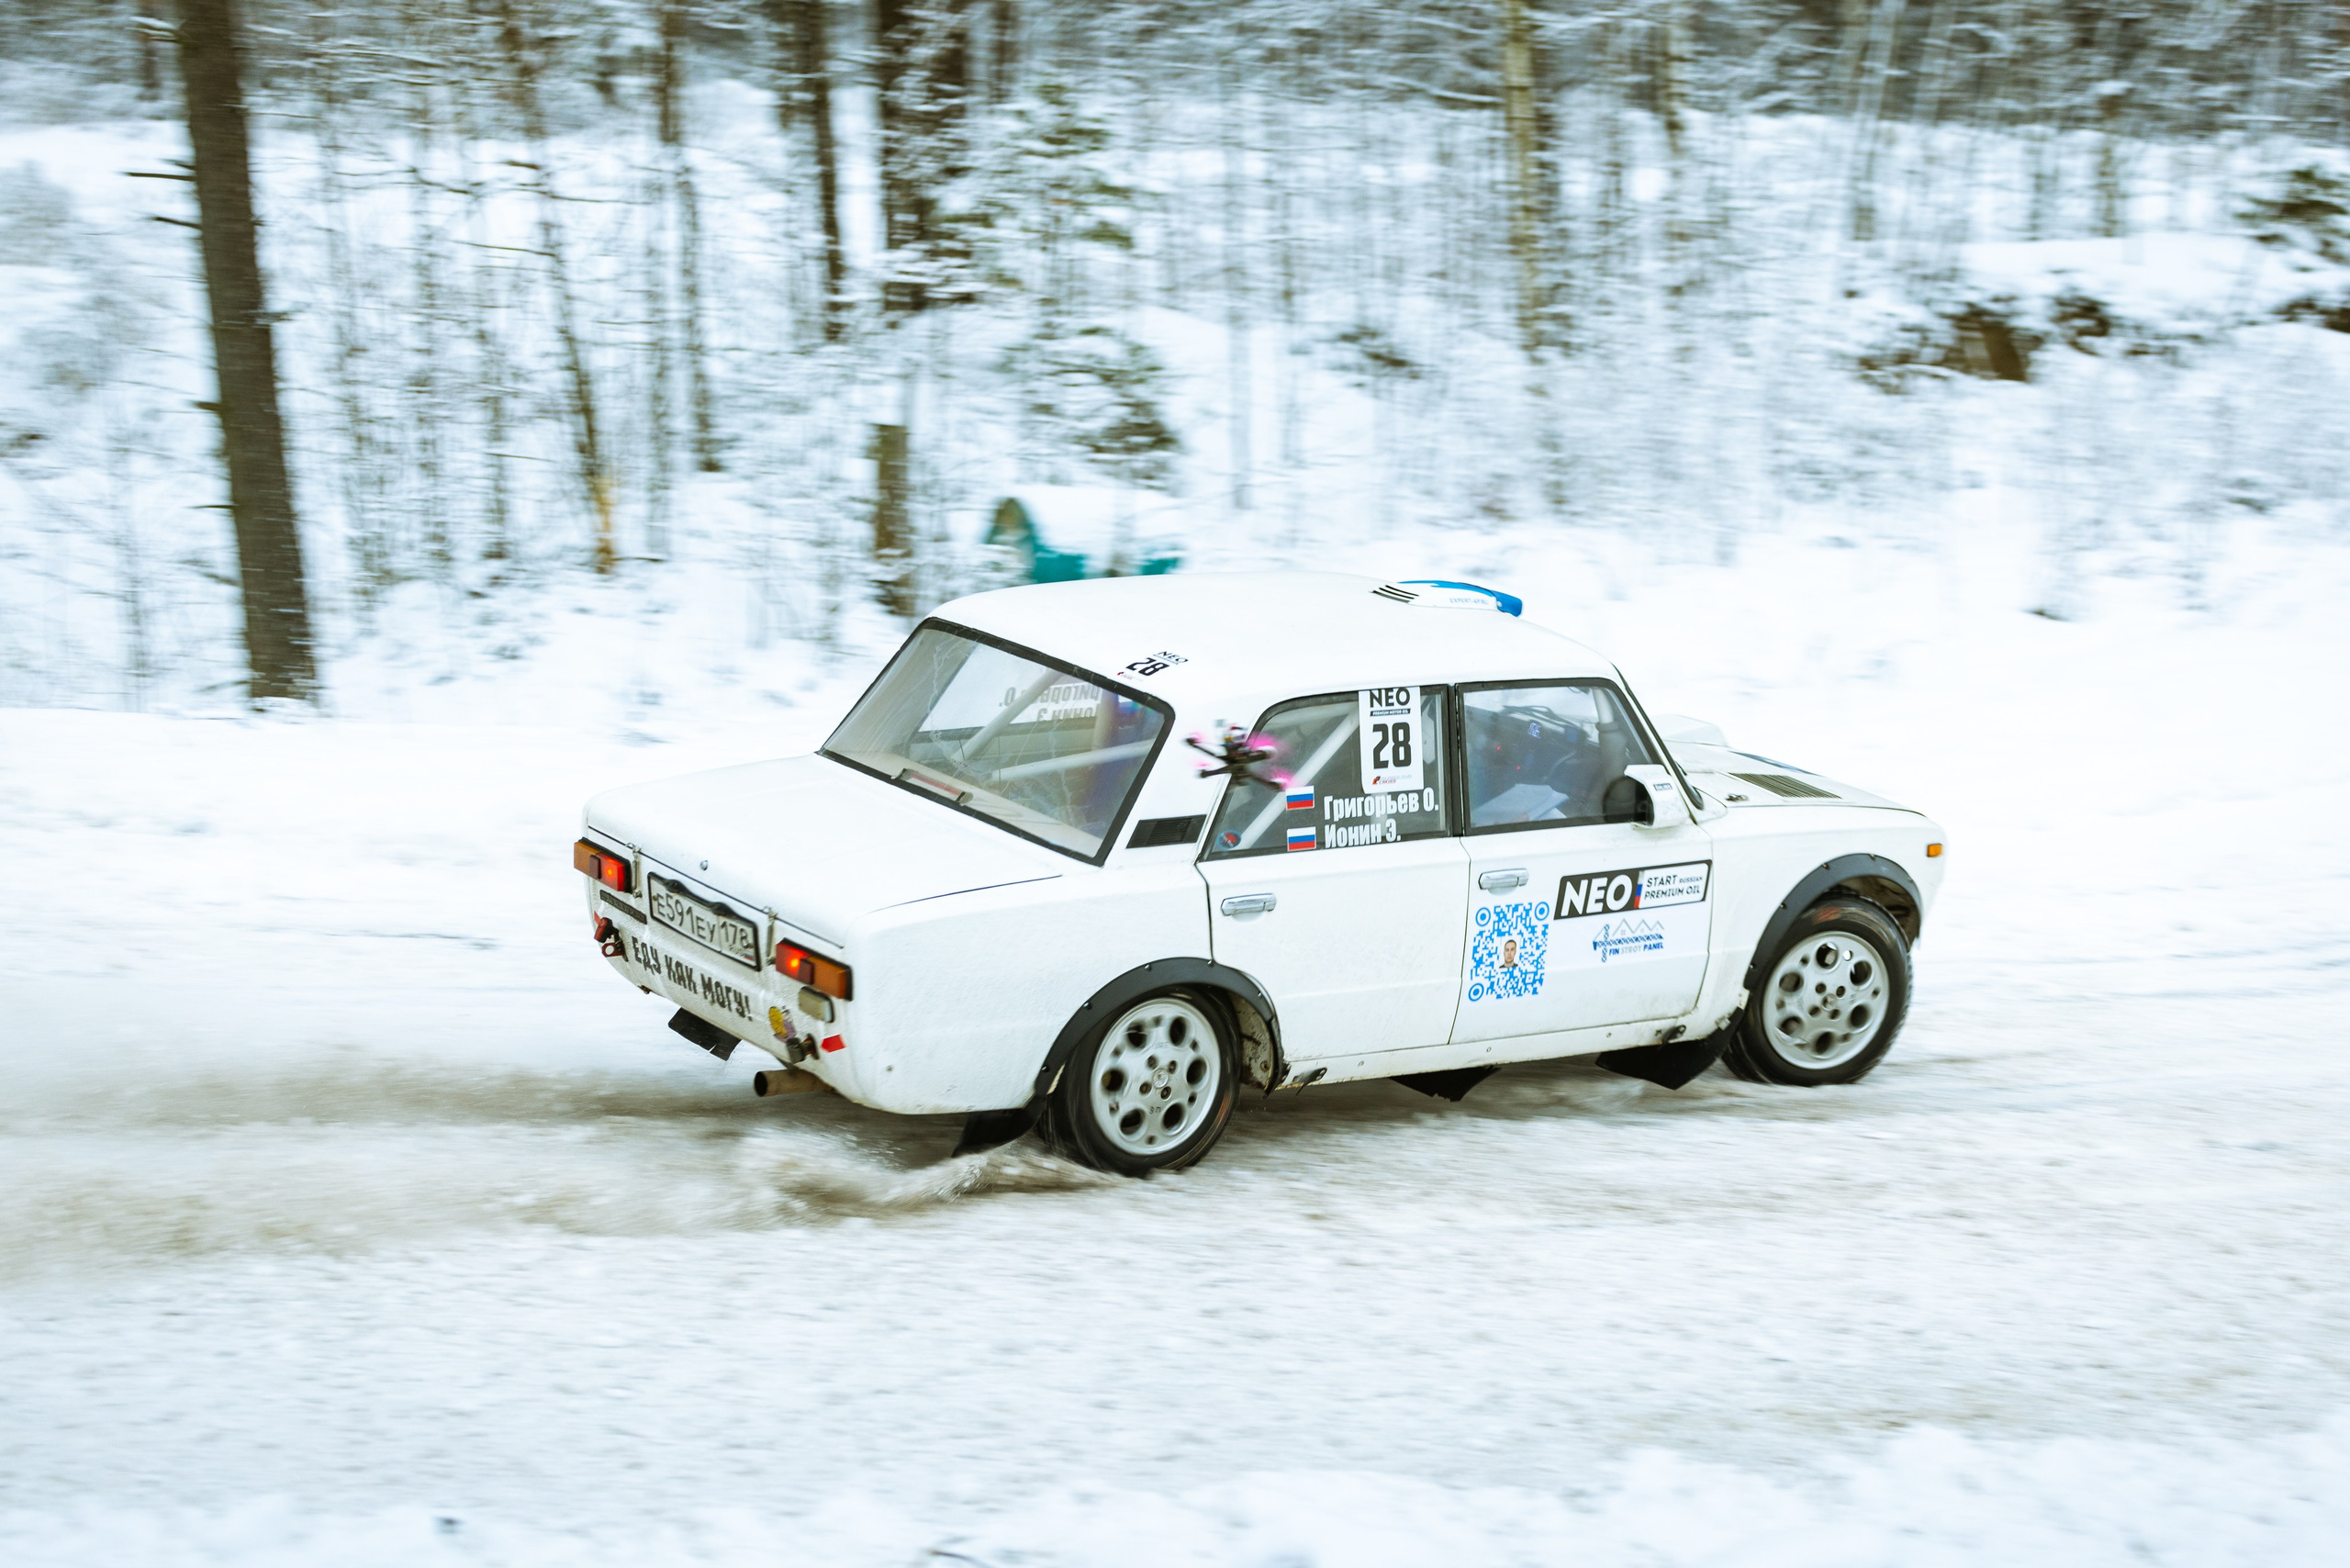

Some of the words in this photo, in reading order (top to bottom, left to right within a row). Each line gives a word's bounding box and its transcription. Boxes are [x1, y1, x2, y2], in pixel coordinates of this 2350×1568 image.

[1125, 657, 1170, 676] 28
[1370, 688, 1411, 708] NEO
[1372, 722, 1412, 769] 28
[1324, 792, 1419, 822] Григорьев
[1423, 787, 1439, 812] О.
[1325, 823, 1382, 848] Ионин
[1561, 874, 1632, 916] NEO
[1647, 875, 1677, 888] START
[1644, 887, 1684, 900] PREMIUM
[1686, 885, 1701, 895] OIL
[1643, 942, 1663, 951] PANEL
[632, 936, 661, 975] ЕДУ
[665, 955, 698, 994] КАК
[700, 973, 753, 1022] МОГУ!
